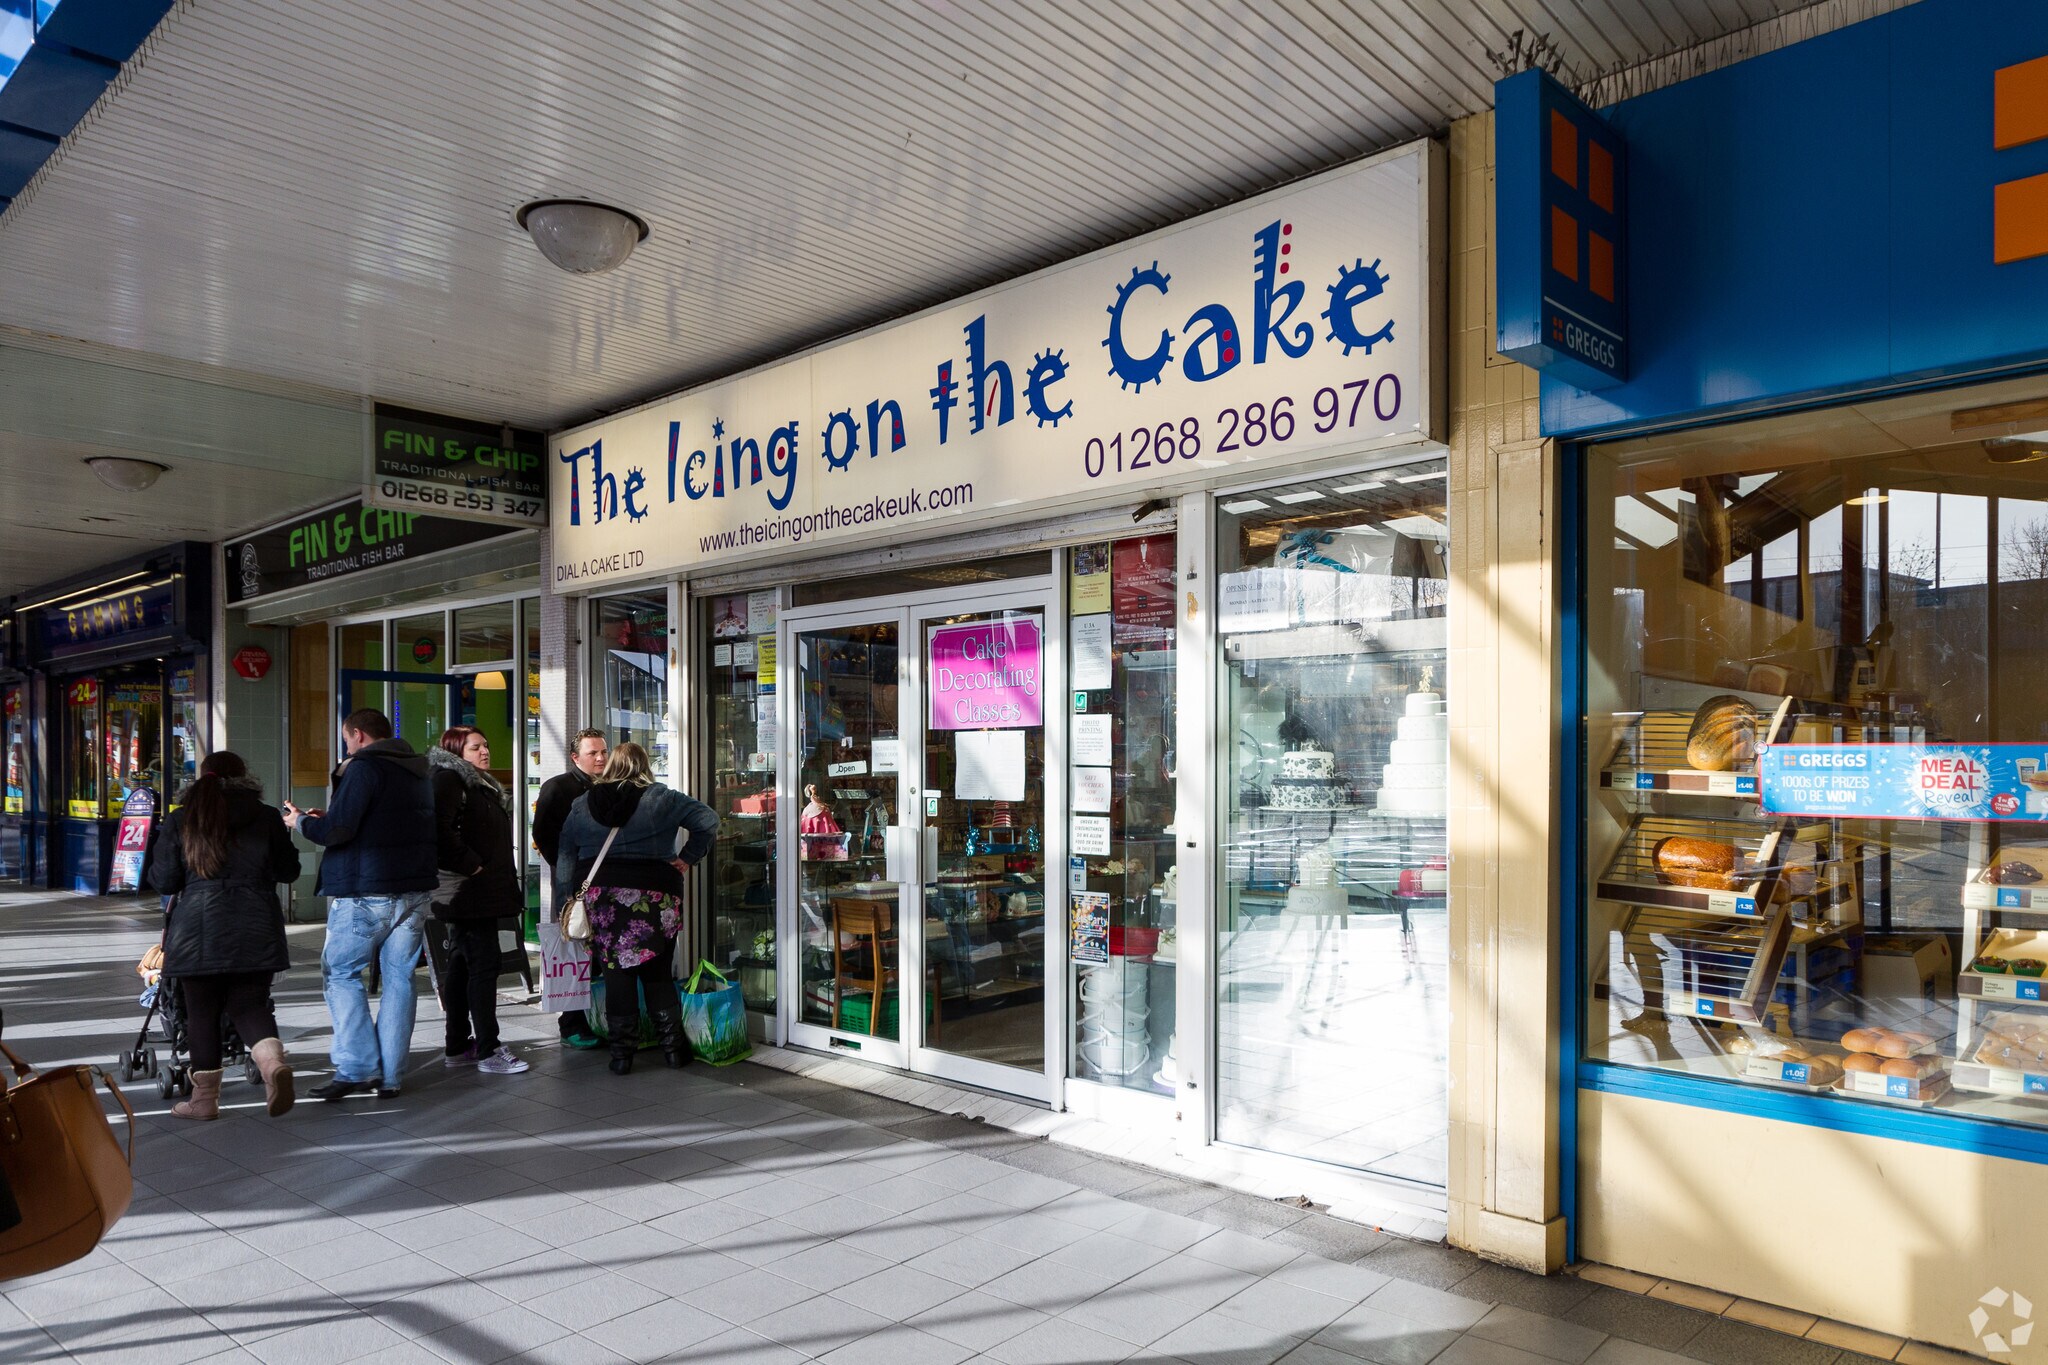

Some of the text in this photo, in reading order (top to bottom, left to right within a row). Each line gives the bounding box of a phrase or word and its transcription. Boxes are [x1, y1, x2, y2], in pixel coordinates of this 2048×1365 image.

[1566, 323, 1615, 369] GREGGS
[559, 218, 1396, 526] The Icing on the Cake
[1084, 373, 1402, 478] 01268 286 970
[384, 430, 539, 472] FIN & CHIP
[382, 460, 541, 493] TRADITIONAL FISH BAR
[381, 480, 541, 517] 01268 293 347
[699, 482, 973, 553] www.theicingonthecakeuk.com
[289, 507, 421, 568] FIN & CHIP
[307, 543, 405, 580] TRADITIONAL FISH BAR
[557, 550, 644, 582] DIAL A CAKE LTD
[1226, 584, 1253, 592] OPENING
[68, 595, 145, 634] GAMING
[963, 634, 1007, 661] Cake
[77, 683, 91, 702] 24
[938, 664, 1037, 696] Decorating
[954, 698, 1021, 724] Classes
[838, 763, 856, 774] Open
[1799, 753, 1981, 774] GREGGS MEAL
[1781, 776, 1870, 788] 1000s OF PRIZES
[1792, 790, 1857, 802] TO BE WON
[1921, 774, 1981, 790] DEAL
[1924, 788, 1974, 805] Reveal
[122, 824, 144, 846] 24
[1786, 1069, 1804, 1078] £1.05
